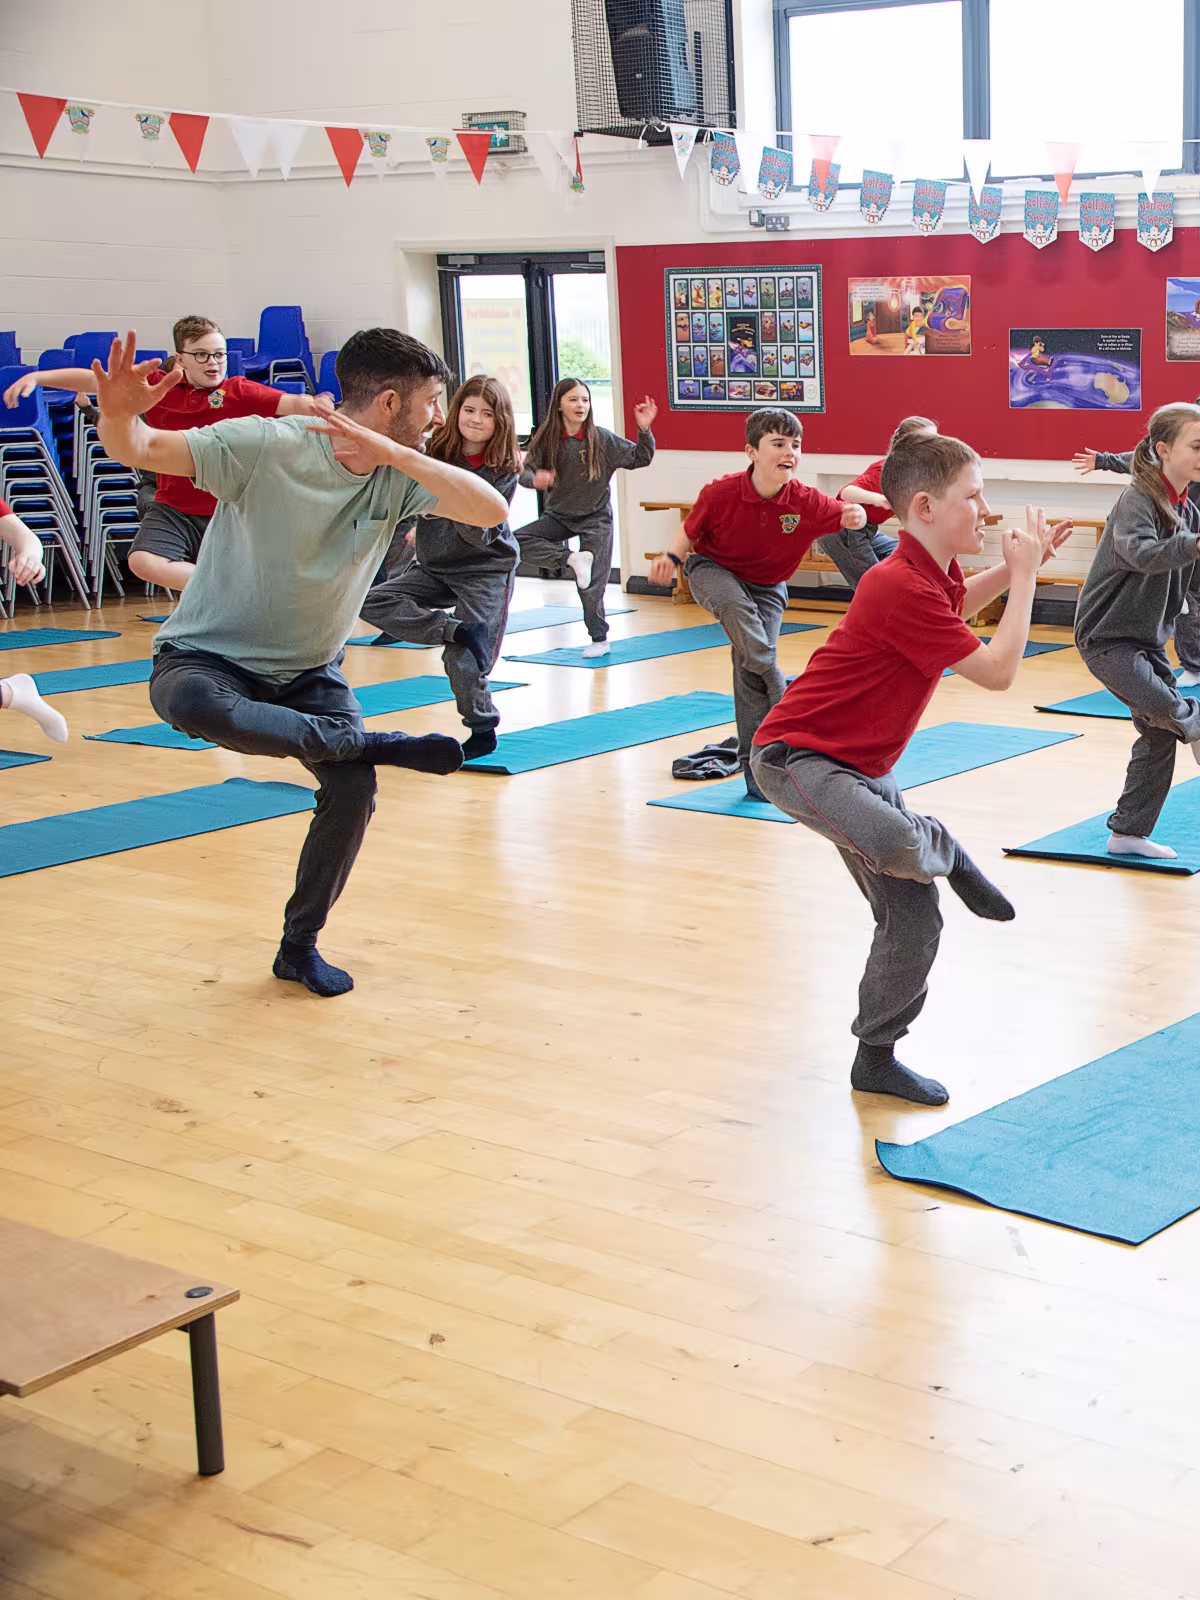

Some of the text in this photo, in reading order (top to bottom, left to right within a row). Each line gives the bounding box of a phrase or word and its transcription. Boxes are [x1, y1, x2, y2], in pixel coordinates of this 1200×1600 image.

[1026, 196, 1057, 213] Nollaig
[1082, 198, 1112, 214] Nollaig
[1026, 210, 1055, 224] Shona
[1082, 212, 1111, 226] Shona
[1140, 213, 1170, 226] Shona
